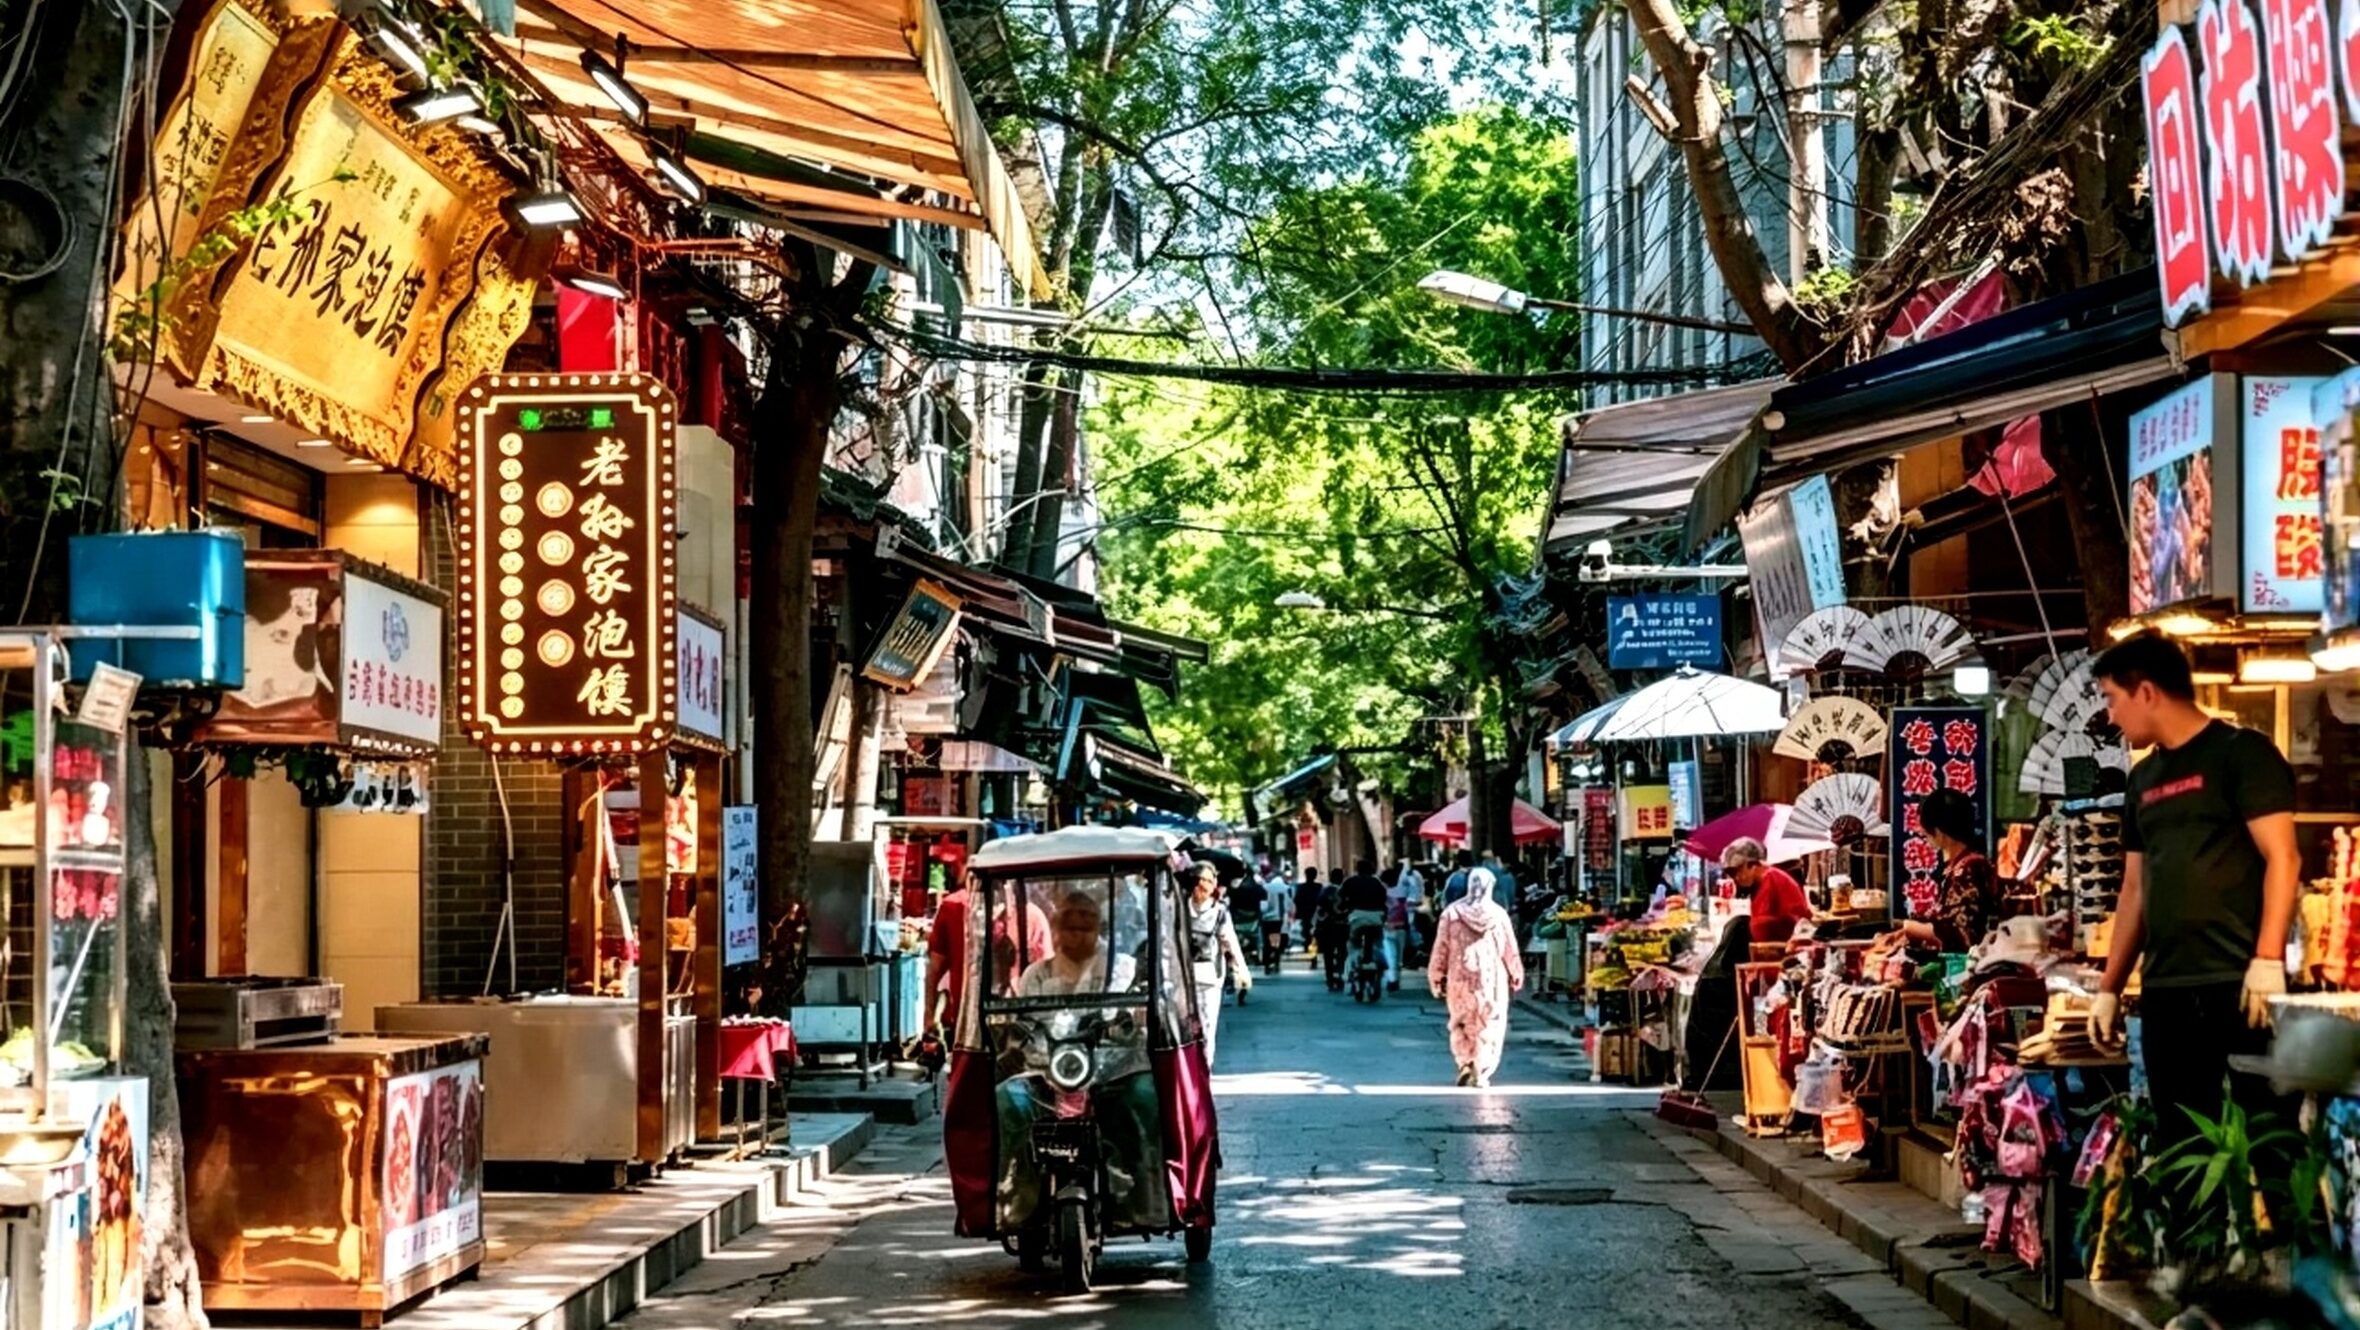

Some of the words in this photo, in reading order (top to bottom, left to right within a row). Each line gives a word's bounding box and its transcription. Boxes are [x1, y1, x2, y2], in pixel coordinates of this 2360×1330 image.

[577, 435, 635, 717] 老孙家泡馍
